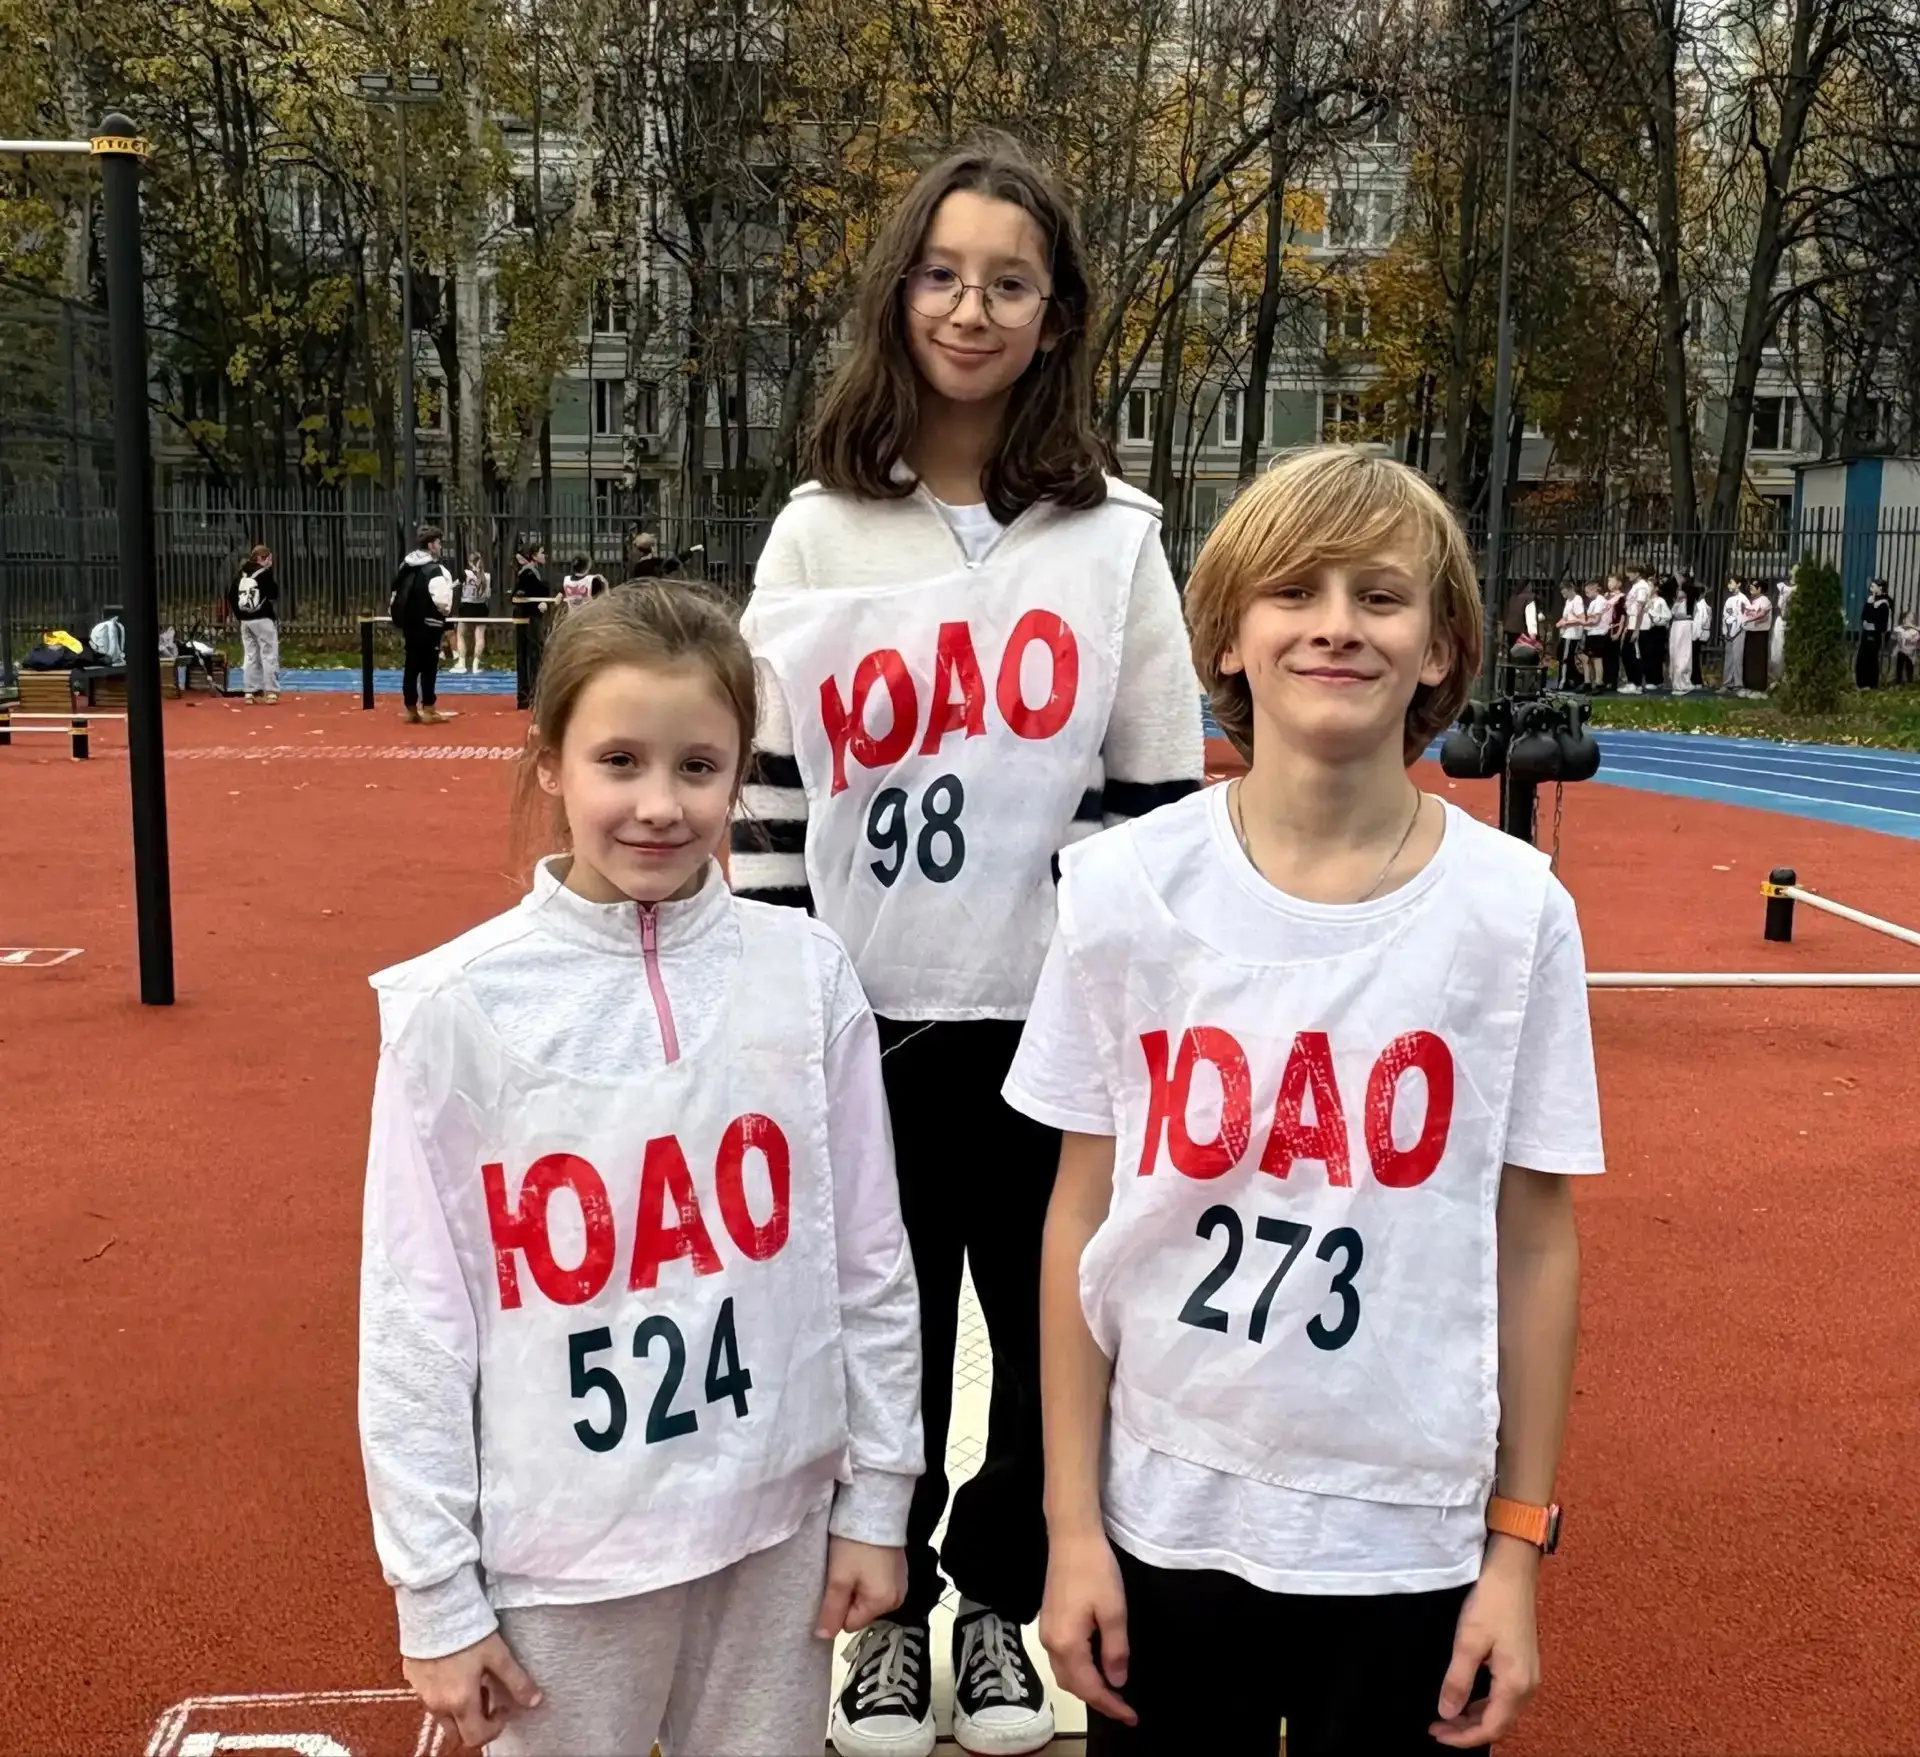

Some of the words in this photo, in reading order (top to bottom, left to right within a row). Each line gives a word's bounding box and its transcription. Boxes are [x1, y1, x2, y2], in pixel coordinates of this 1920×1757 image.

[820, 609, 1079, 797] ЮАО
[867, 774, 966, 887] 98
[1138, 1026, 1455, 1189] ЮАО
[482, 1113, 790, 1310] ЮАО
[1178, 1204, 1364, 1351] 273
[568, 1296, 753, 1453] 524
